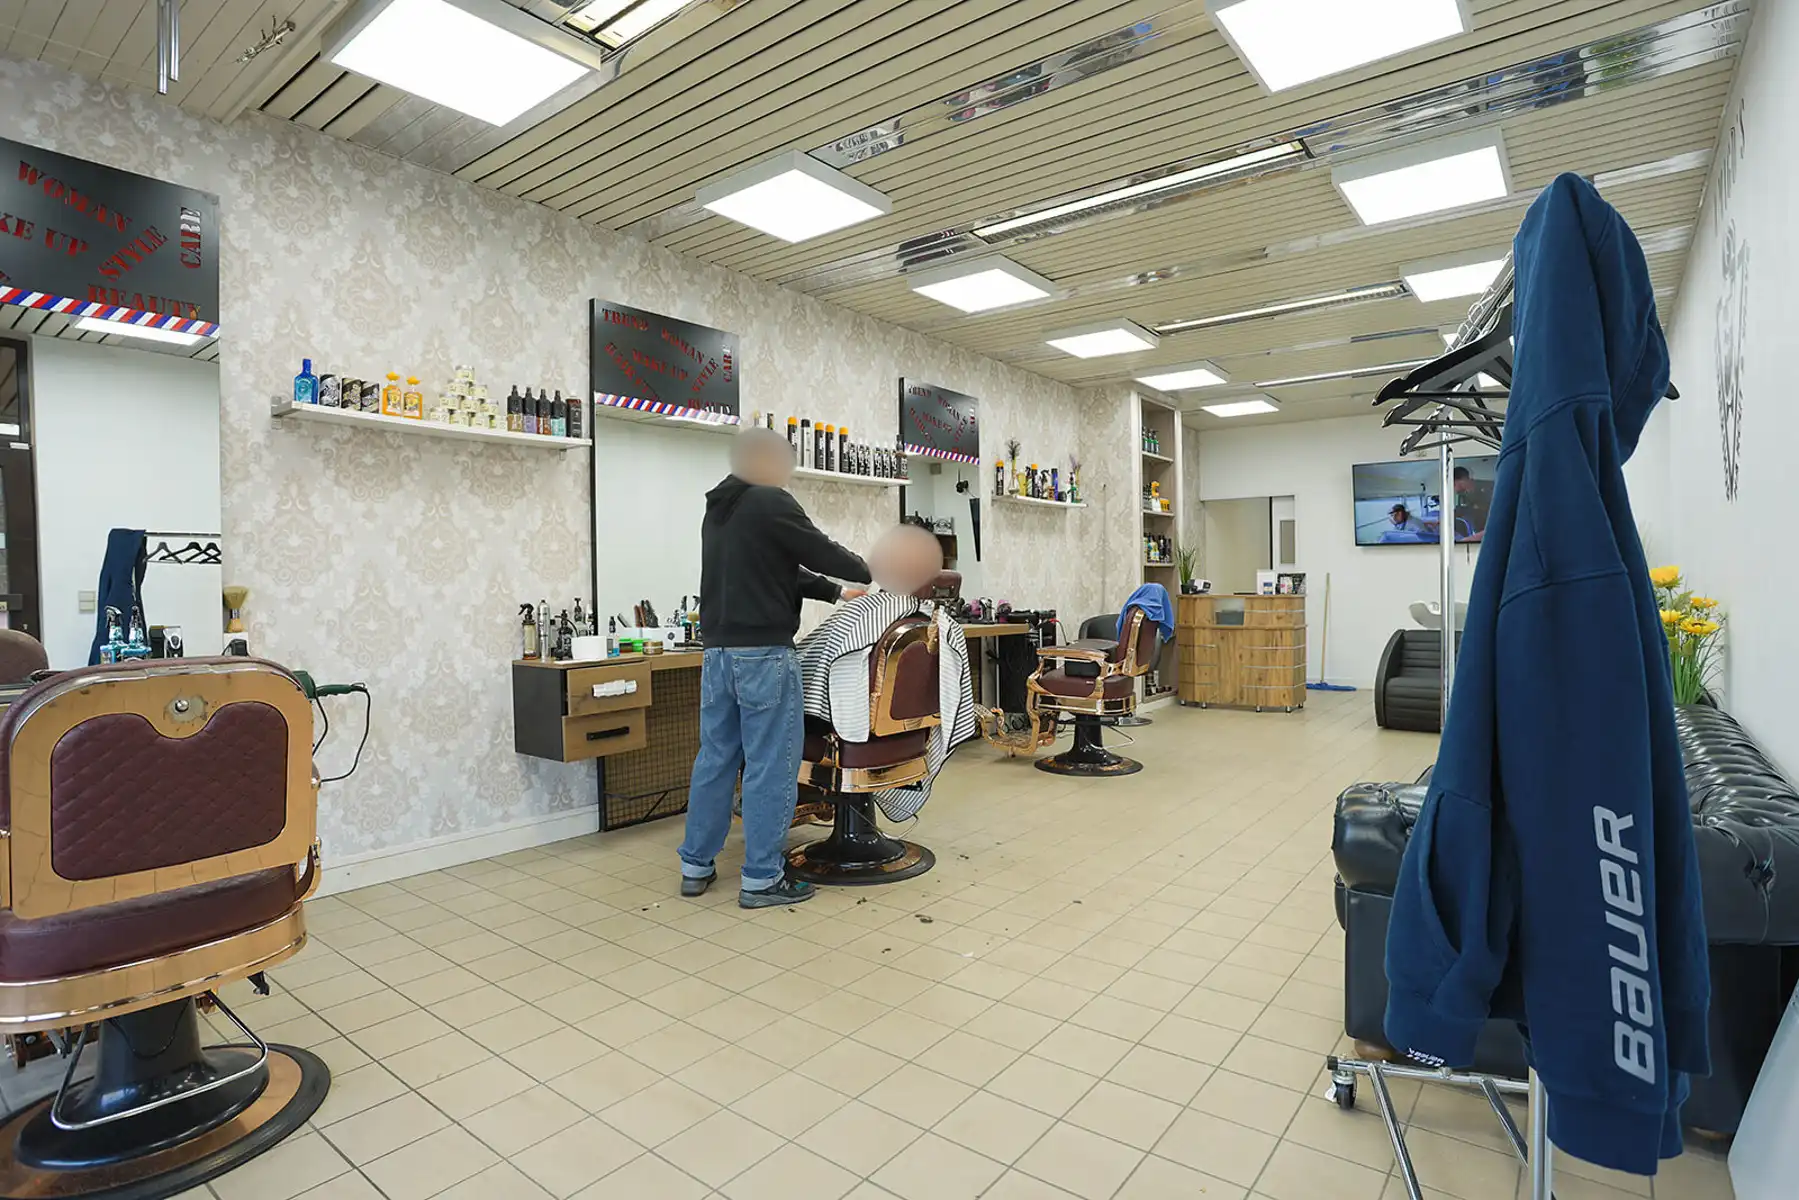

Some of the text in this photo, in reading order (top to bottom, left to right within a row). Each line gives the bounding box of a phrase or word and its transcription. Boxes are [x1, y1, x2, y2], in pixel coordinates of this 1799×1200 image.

[18, 160, 132, 233] WOMAN
[44, 228, 90, 257] UP
[98, 225, 168, 282] STYLE
[87, 284, 201, 320] BEAUTY
[602, 308, 649, 331] TREND
[661, 327, 705, 365] WOMAN
